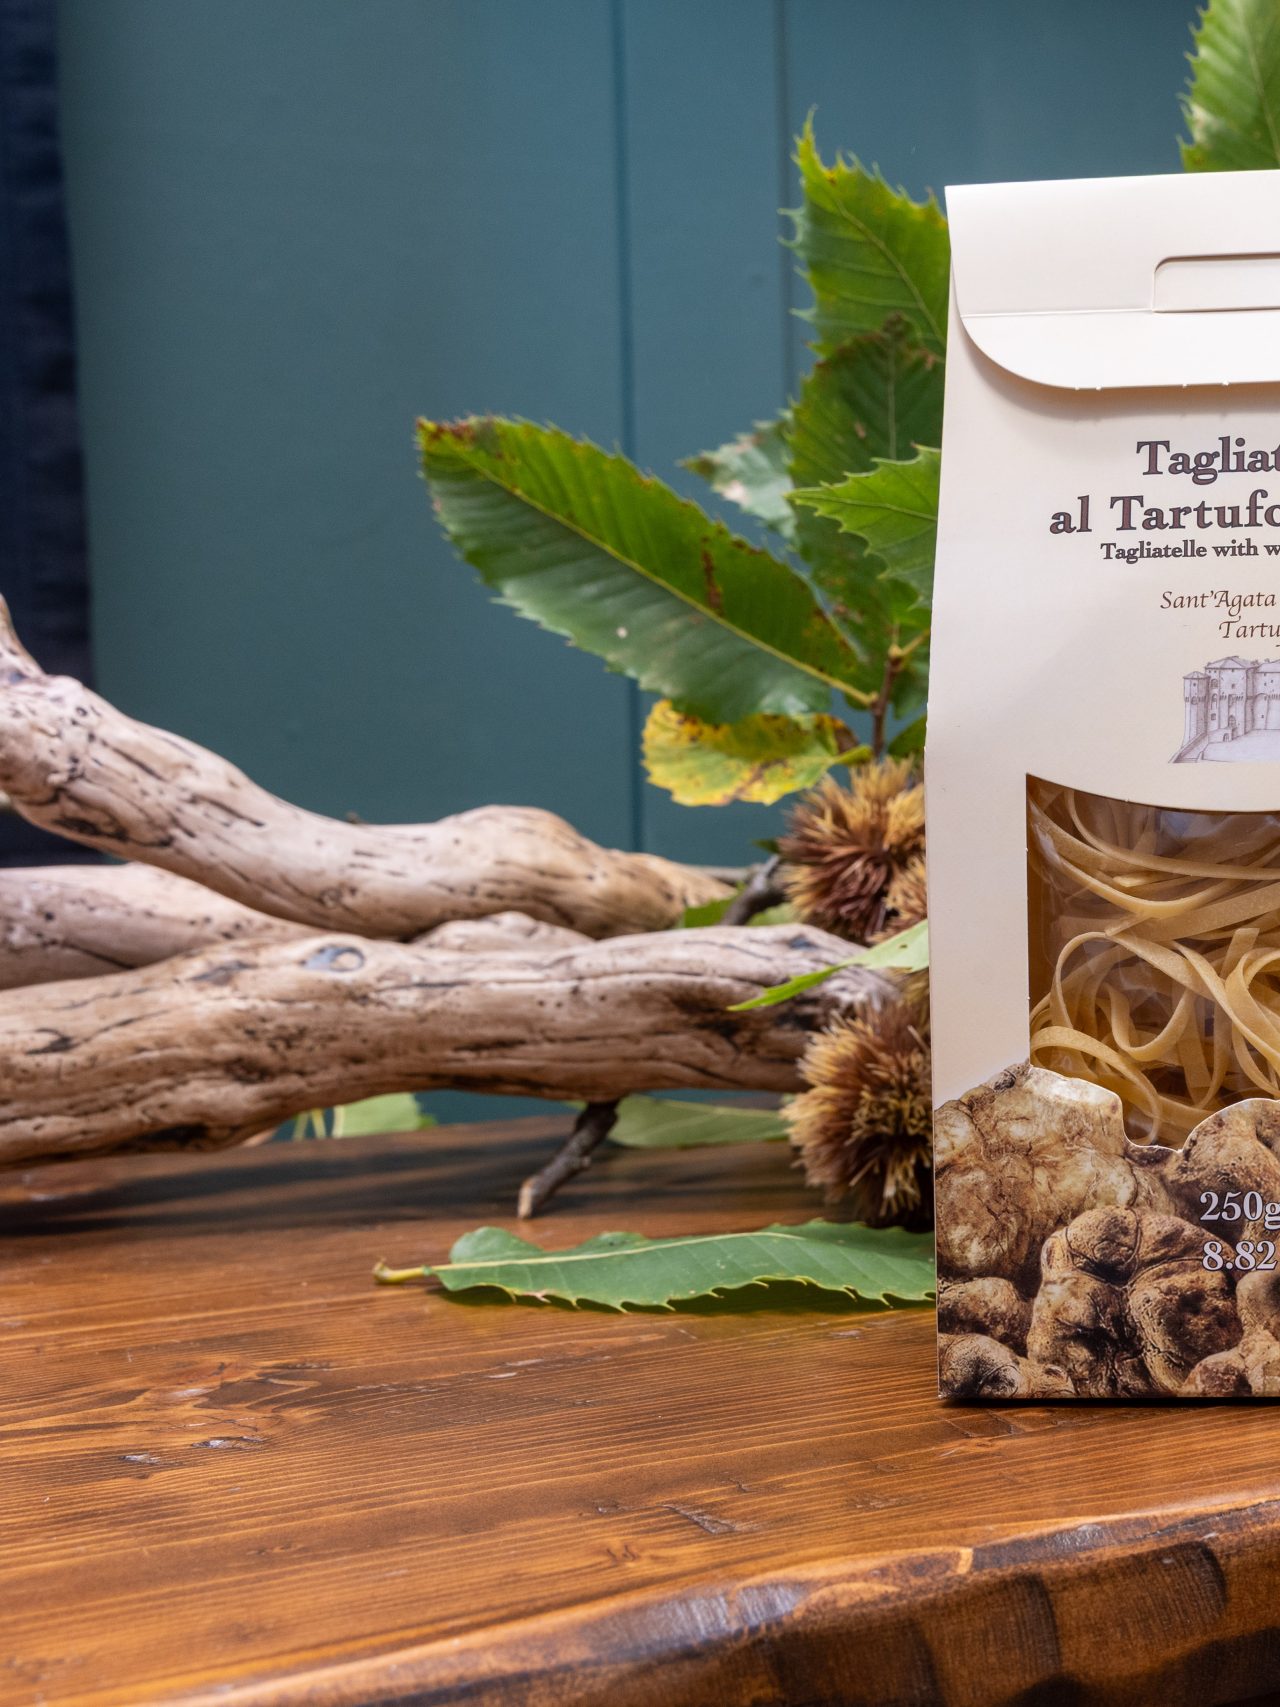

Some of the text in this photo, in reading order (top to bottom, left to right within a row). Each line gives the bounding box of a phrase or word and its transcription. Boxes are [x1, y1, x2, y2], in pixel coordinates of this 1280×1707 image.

[1049, 495, 1093, 534] al
[1100, 539, 1208, 564] Tagliatelle
[1212, 538, 1259, 557] with
[1160, 587, 1277, 617] Sant'Agata
[1201, 1240, 1278, 1271] 8.82
